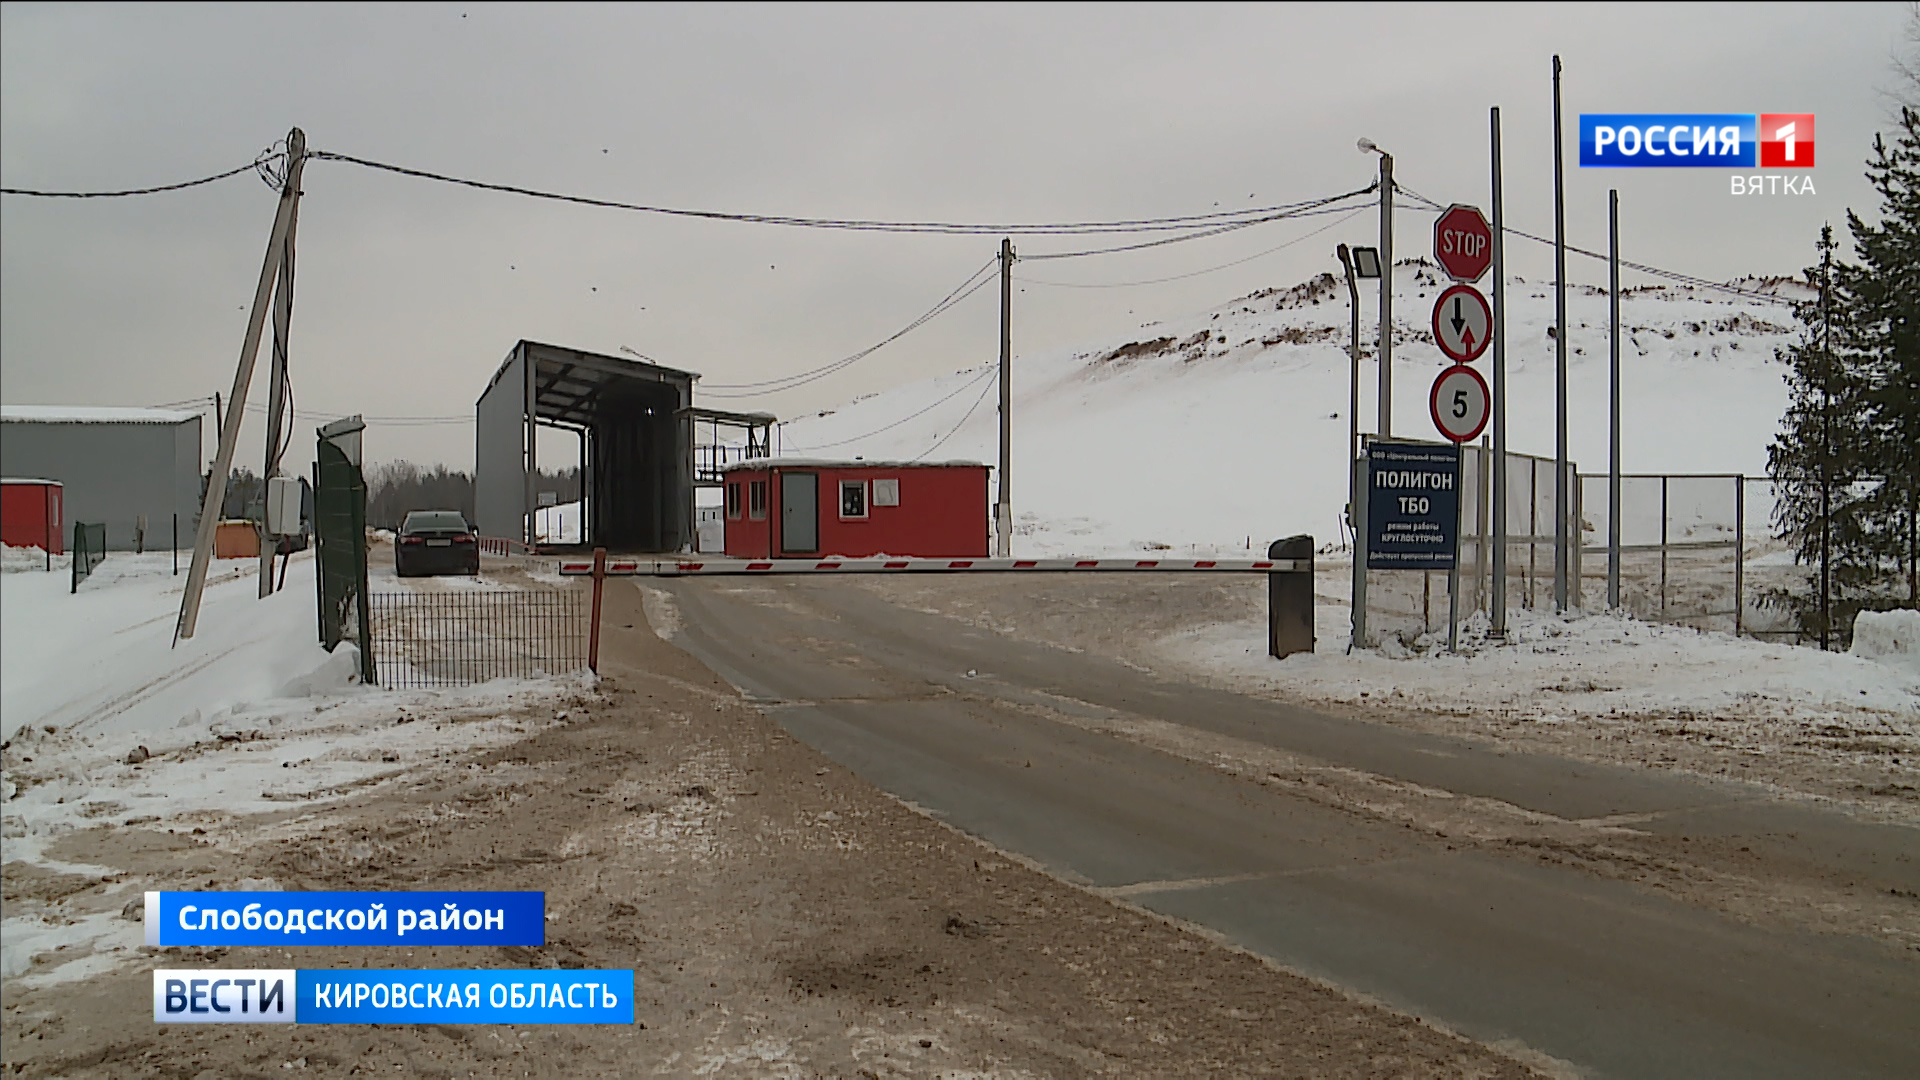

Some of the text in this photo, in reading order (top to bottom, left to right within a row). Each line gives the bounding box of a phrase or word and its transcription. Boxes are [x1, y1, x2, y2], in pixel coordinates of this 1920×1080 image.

[1443, 229, 1486, 258] STOP
[1452, 390, 1468, 419] 5
[1376, 470, 1453, 490] ПОЛИГОН
[1398, 497, 1429, 514] ТБО
[1413, 521, 1439, 531] работы
[1381, 533, 1444, 543] КРУГЛОСУТОЧНО
